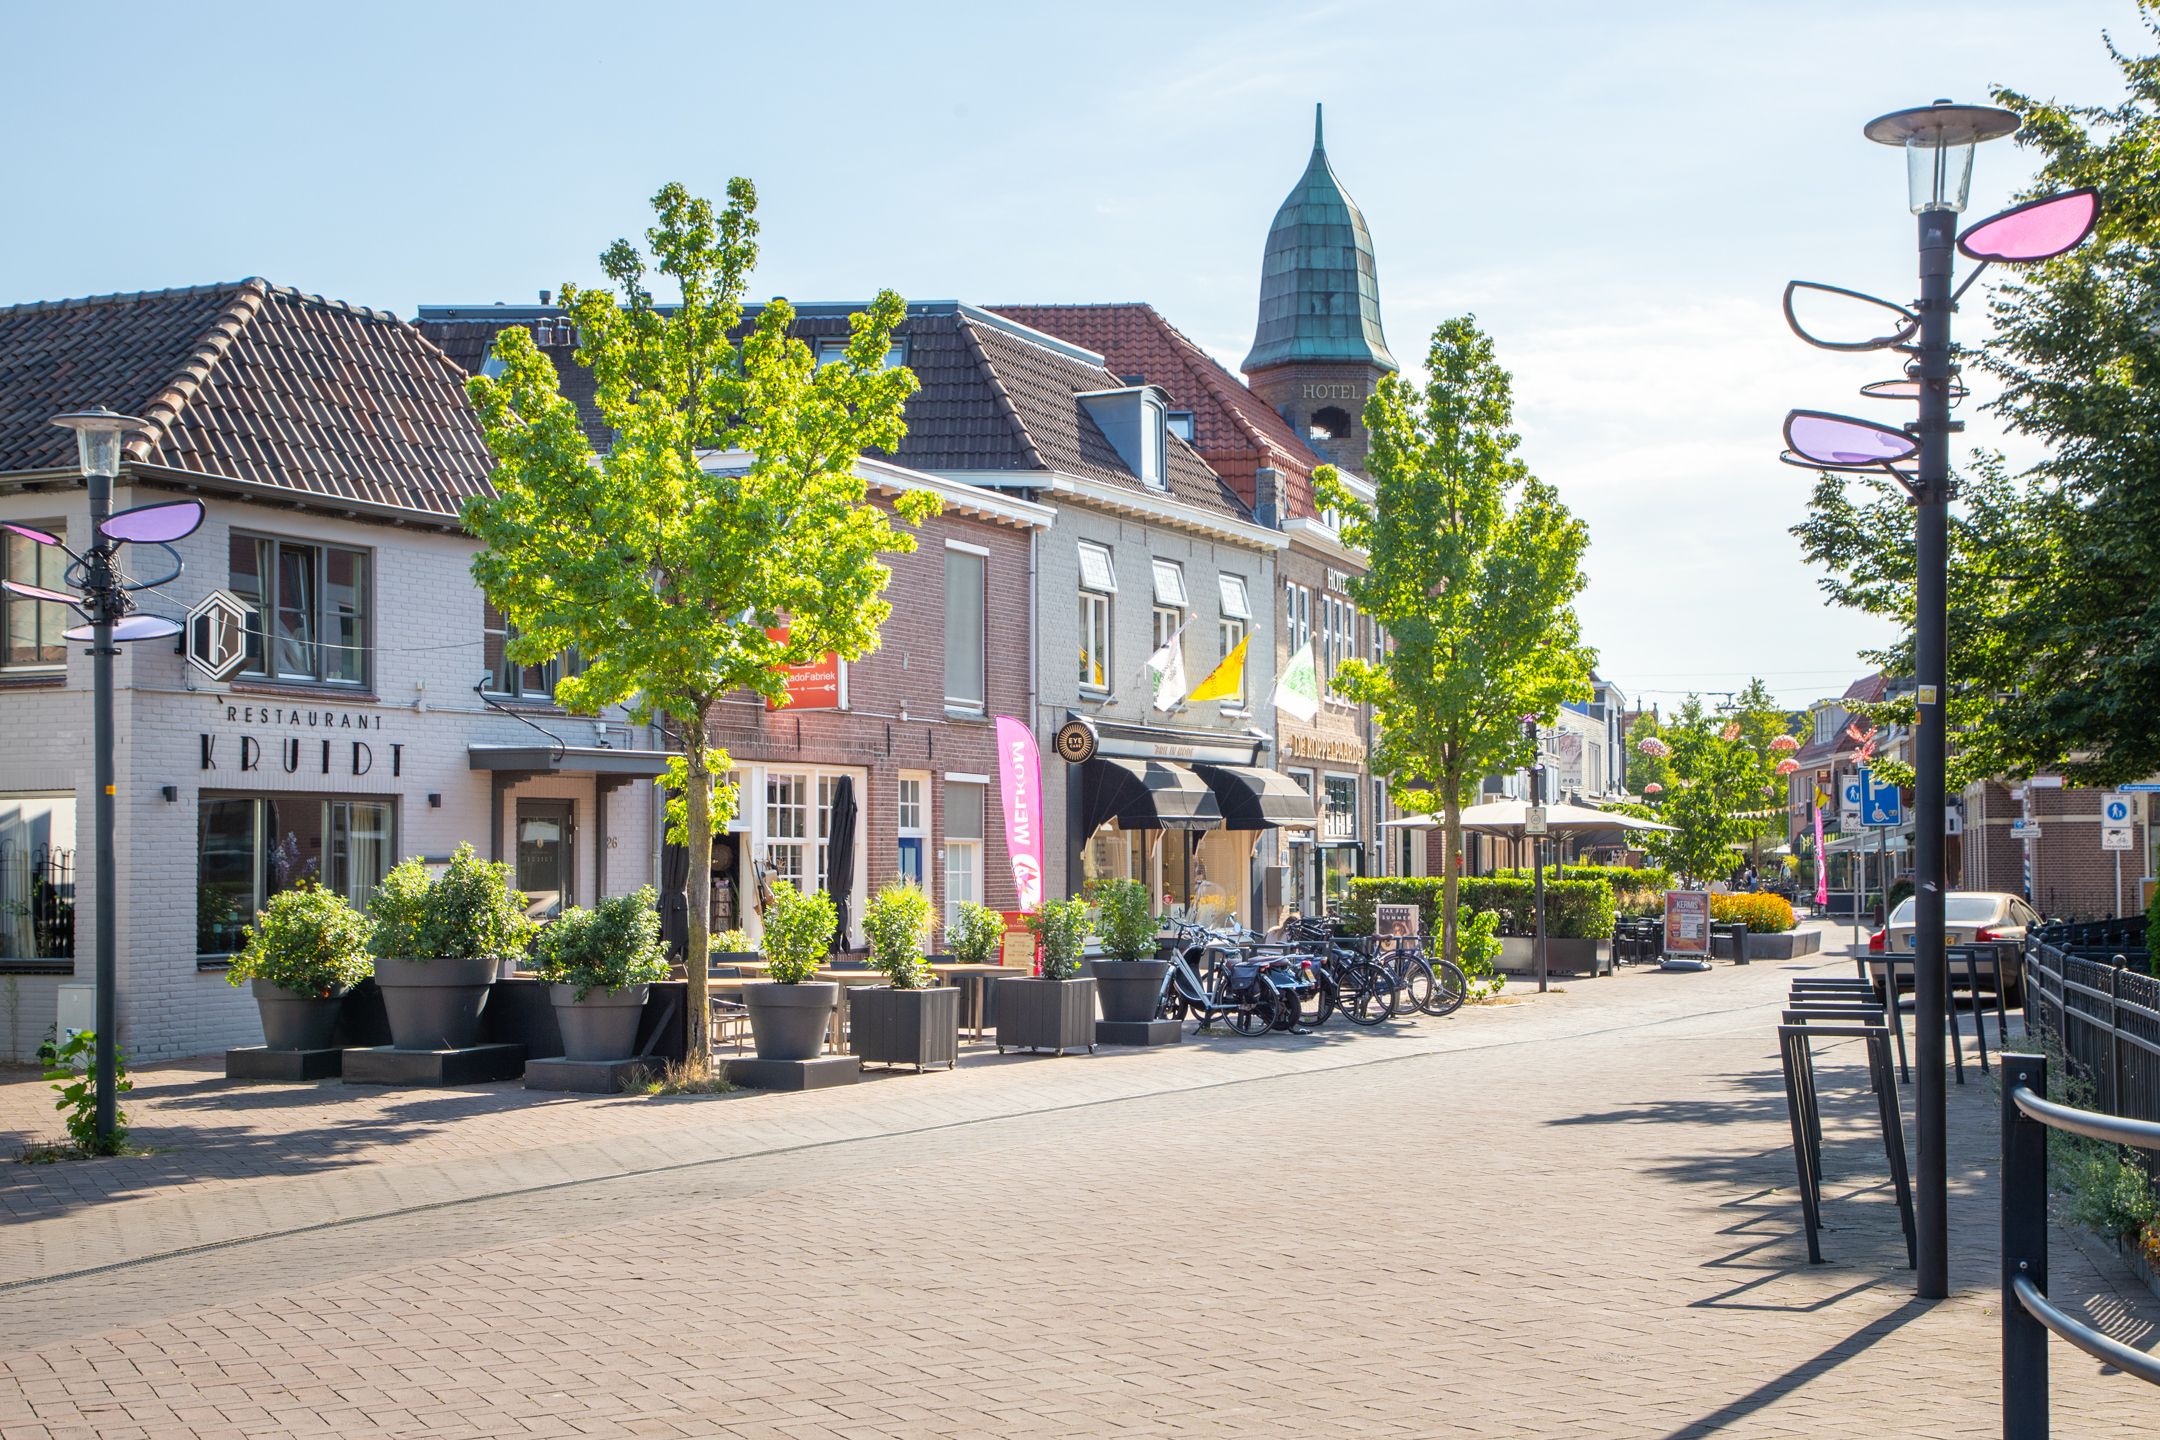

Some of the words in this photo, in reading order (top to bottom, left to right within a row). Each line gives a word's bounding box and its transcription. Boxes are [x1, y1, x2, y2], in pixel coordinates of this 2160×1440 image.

[1302, 384, 1361, 400] HOTEL
[786, 671, 836, 682] adoFabriek
[227, 706, 382, 730] RESTAURANT
[200, 733, 405, 777] KRUIDT
[606, 836, 618, 849] 26
[1676, 900, 1699, 909] KERMIS
